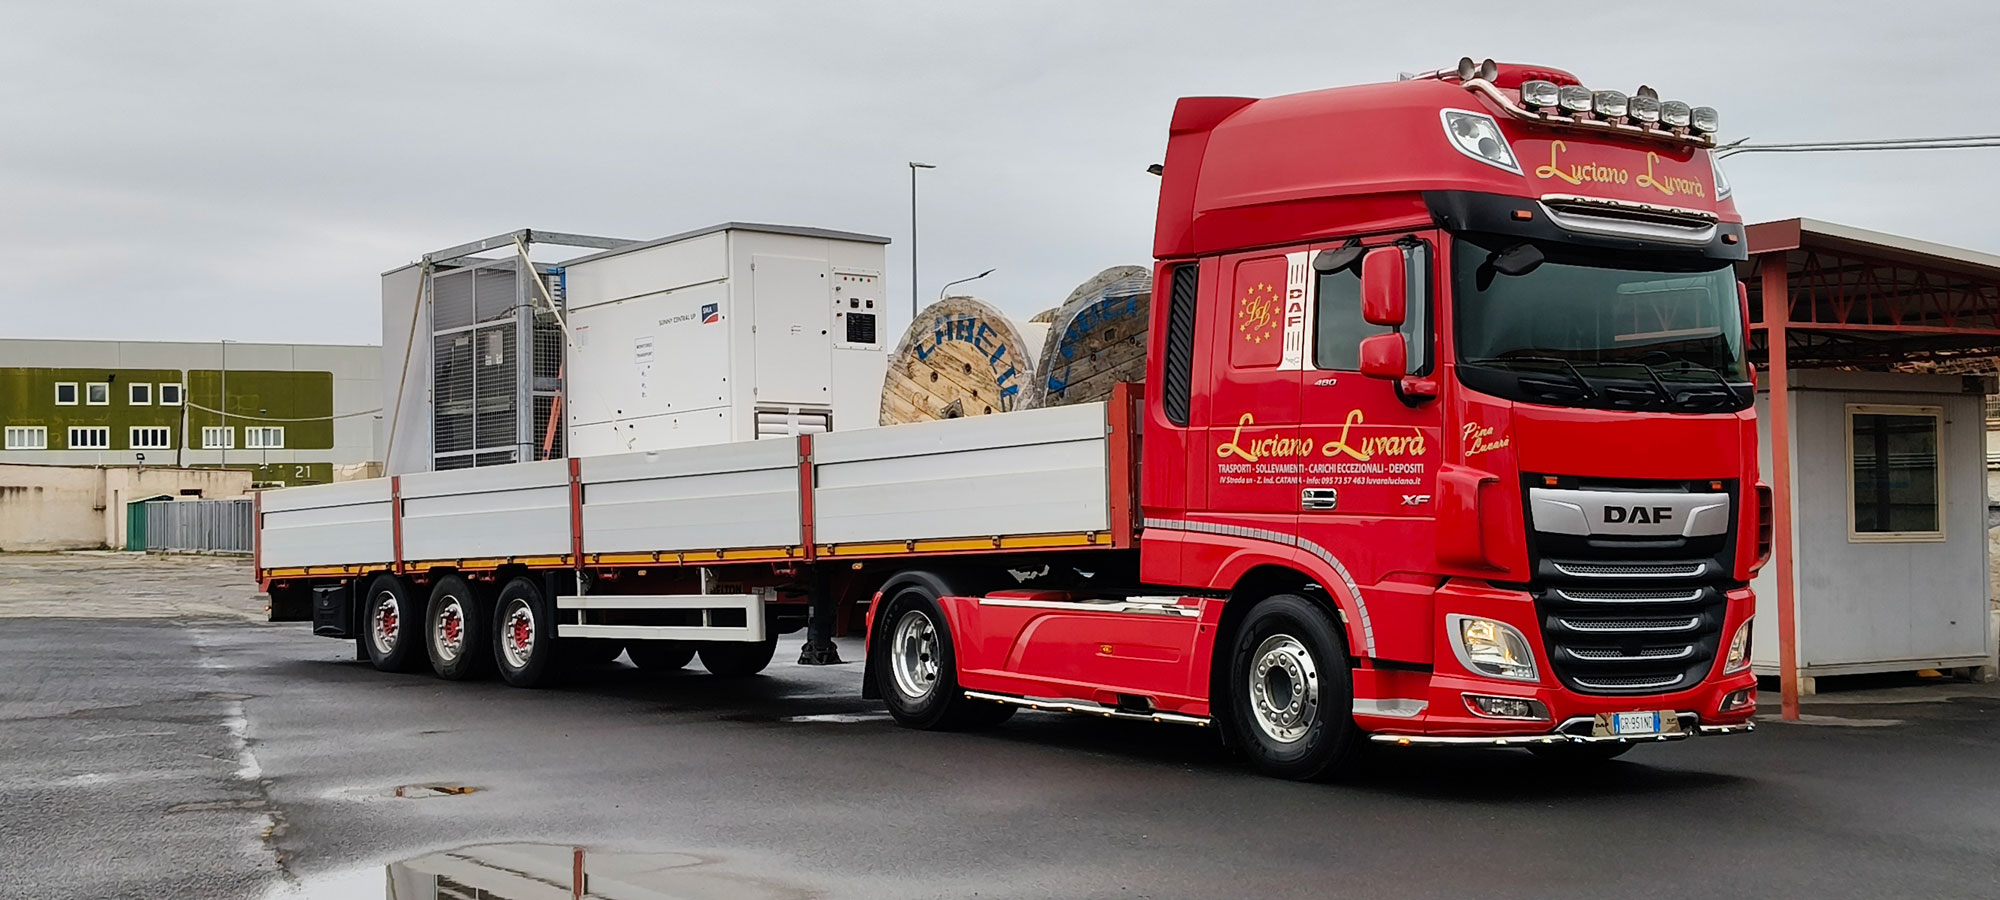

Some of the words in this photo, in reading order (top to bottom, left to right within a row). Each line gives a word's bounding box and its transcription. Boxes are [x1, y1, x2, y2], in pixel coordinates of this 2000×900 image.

[1535, 139, 1629, 186] Luciano
[1636, 151, 1705, 198] Luvarà
[703, 306, 712, 314] SMA
[1288, 289, 1302, 327] DAF
[1216, 412, 1313, 462] Luciano
[1321, 409, 1426, 462] Luvarà
[295, 465, 311, 478] 21
[1218, 463, 1252, 474] TRASPORTI
[1255, 463, 1305, 474] SOLLEVAMENTI
[1308, 463, 1336, 474] CARICHI
[1337, 463, 1384, 474] ECCEZIONALI
[1389, 463, 1424, 474] DEPOSITI
[1321, 476, 1334, 485] 095
[1334, 476, 1343, 485] 73
[1343, 476, 1352, 485] 57
[1353, 476, 1365, 485] 463
[1401, 495, 1431, 505] XF
[1603, 505, 1673, 525] DAF
